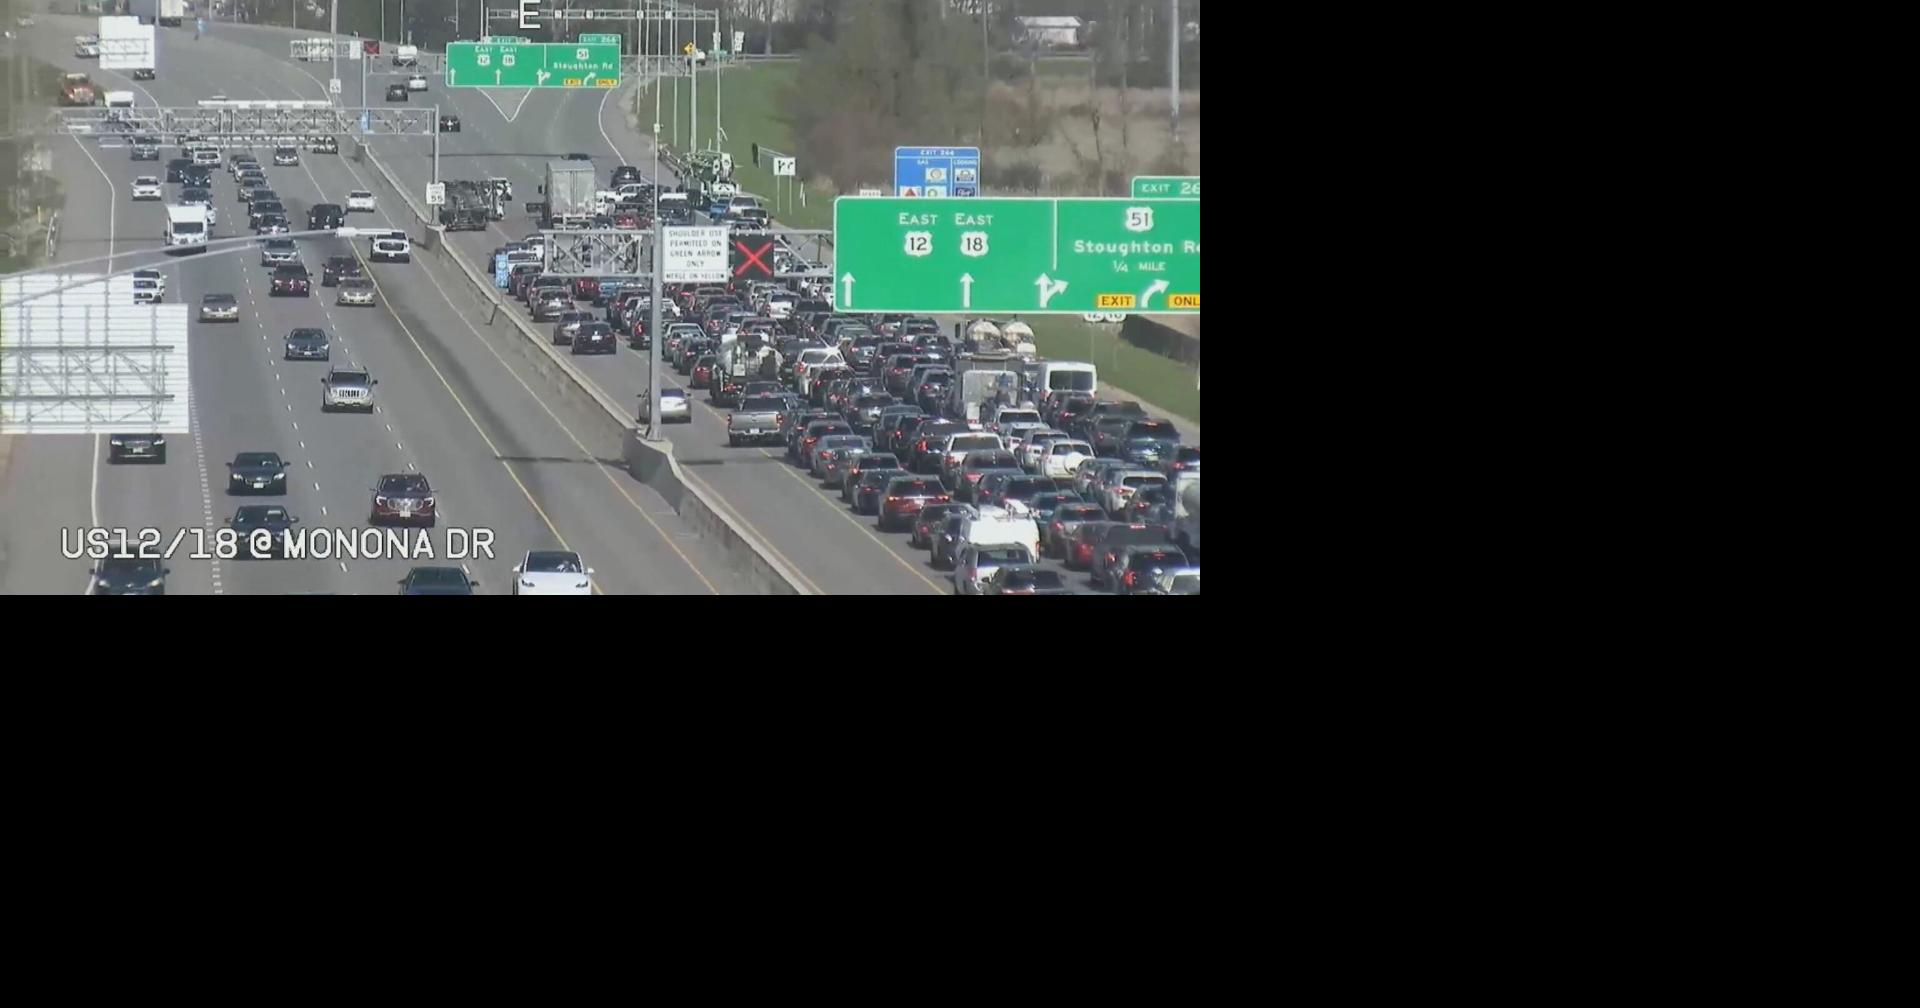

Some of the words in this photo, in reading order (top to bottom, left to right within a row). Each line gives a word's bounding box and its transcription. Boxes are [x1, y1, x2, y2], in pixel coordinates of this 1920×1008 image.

[1141, 183, 1171, 193] EXIT
[899, 212, 938, 225] EAST
[955, 213, 994, 226] EAST
[1131, 212, 1149, 227] 51
[909, 237, 928, 251] 12
[966, 237, 984, 252] 18
[1074, 240, 1173, 257] Stoughton
[1139, 262, 1166, 271] MILE
[1101, 295, 1133, 307] EXIT
